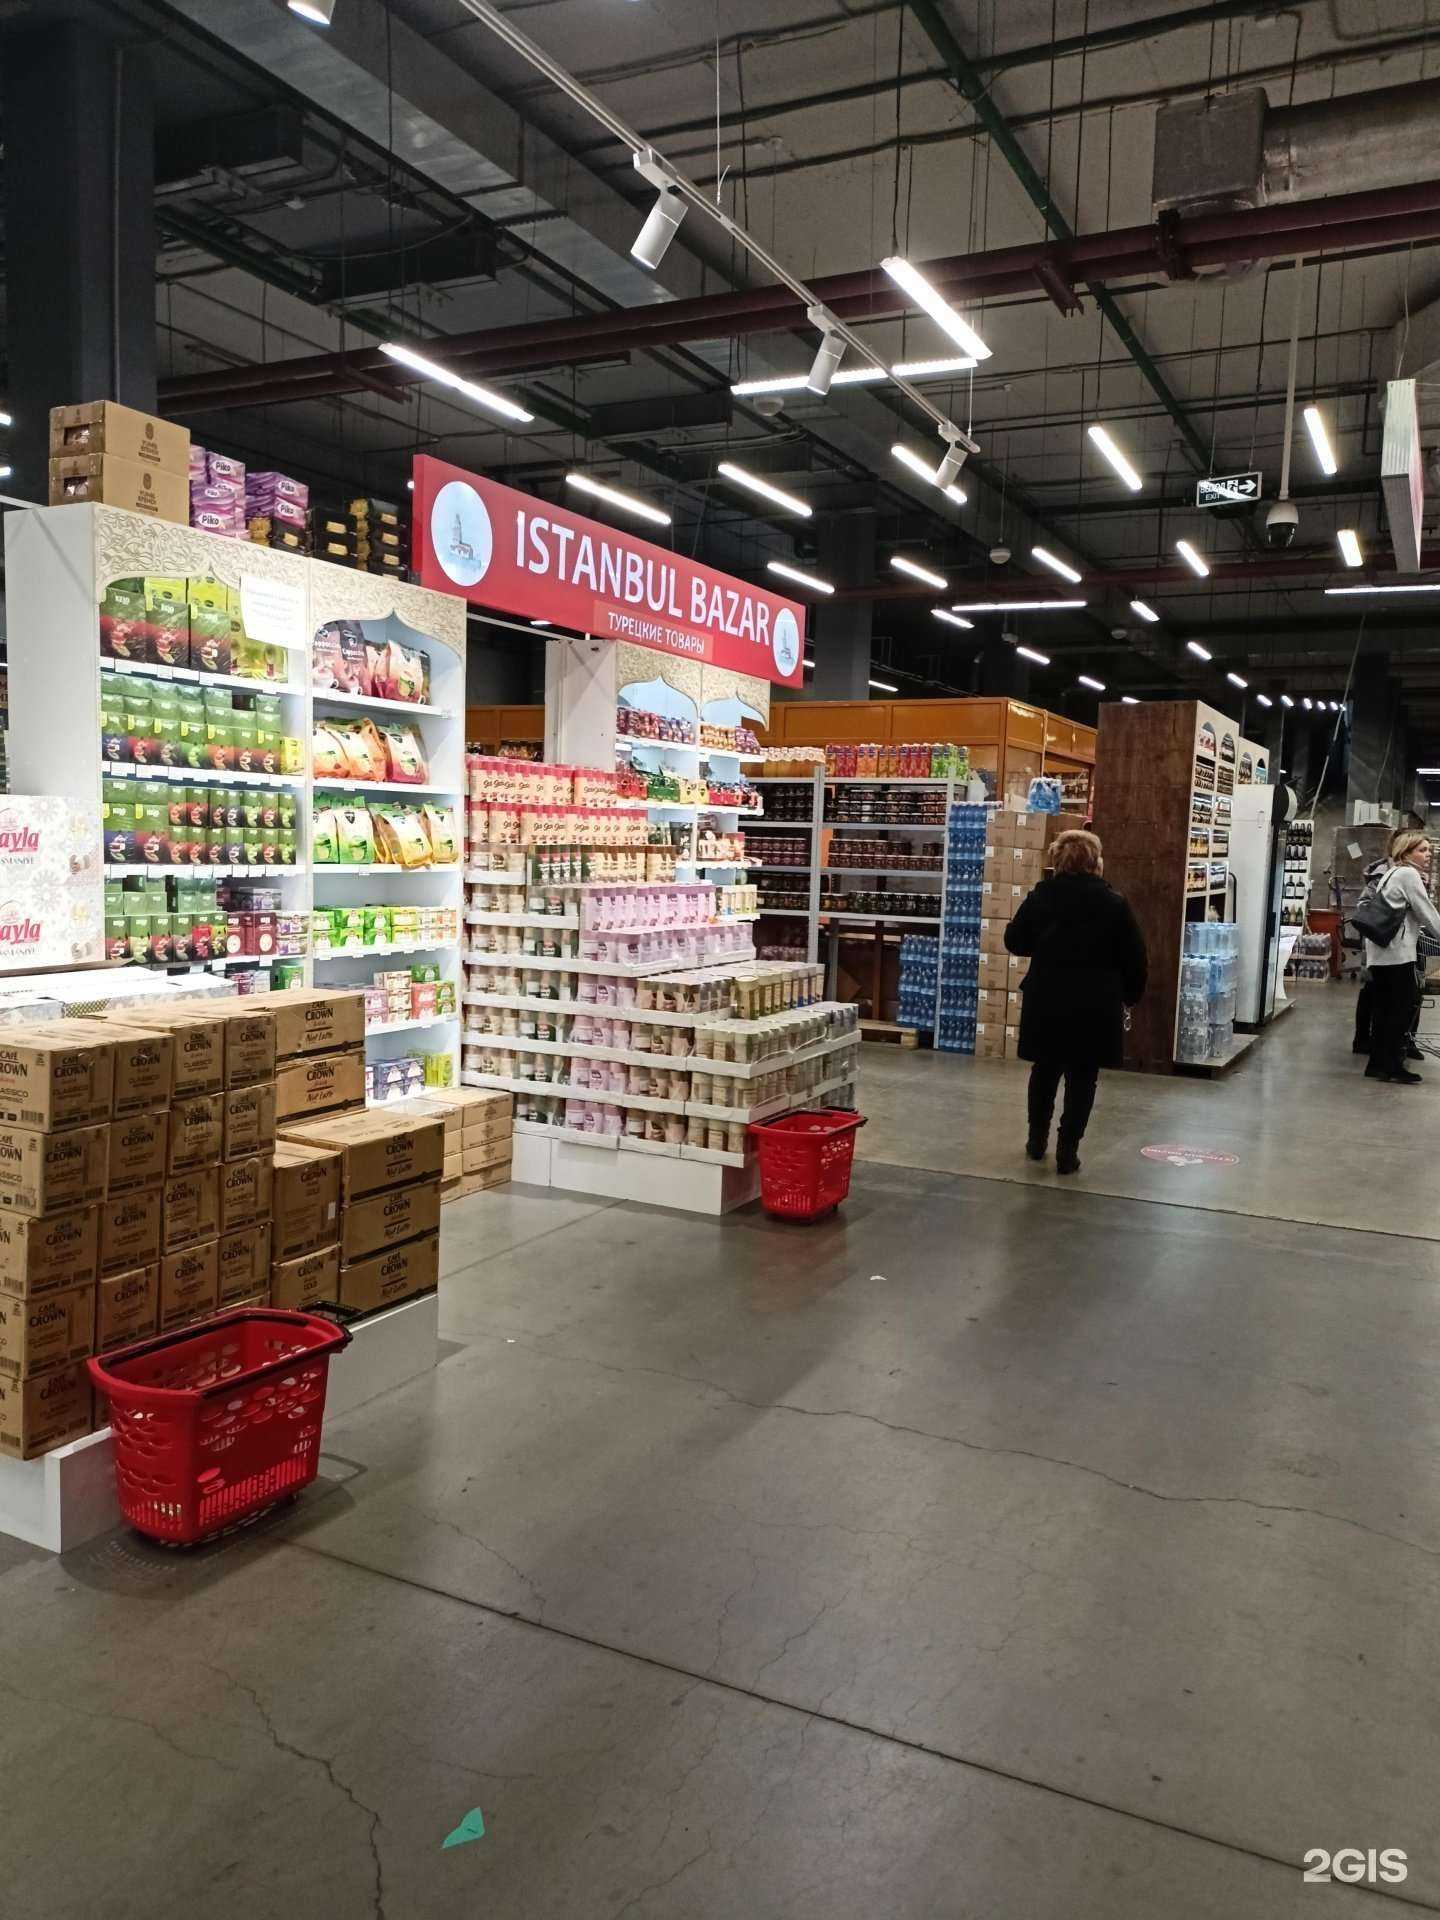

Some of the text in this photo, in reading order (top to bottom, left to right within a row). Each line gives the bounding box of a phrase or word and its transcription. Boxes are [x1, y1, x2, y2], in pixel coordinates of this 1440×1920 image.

[216, 462, 231, 472] Piko
[280, 482, 295, 492] Piko
[280, 503, 294, 514] Piko
[201, 515, 219, 525] Piko
[516, 510, 770, 646] ISTANBUL BAZAR
[608, 612, 704, 654] ТУРЕЦКИЕ ТОВАРЫ
[0, 826, 39, 852] ayla
[0, 918, 41, 944] ayla
[305, 1008, 333, 1021] CROWN
[240, 1030, 266, 1042] CROWN
[184, 1040, 212, 1052] CROWN
[130, 1054, 161, 1067] CROWN
[0, 1063, 28, 1077] ROWN
[54, 1064, 88, 1078] CROWN
[307, 1067, 334, 1081] CROWN
[229, 1103, 256, 1115] CROWN
[122, 1132, 154, 1146] CROWN
[0, 1147, 22, 1161] OWN
[46, 1147, 82, 1162] CROWN
[386, 1140, 415, 1155] CROWN
[226, 1175, 254, 1188] CROWN
[300, 1168, 327, 1183] CROWN
[384, 1199, 410, 1216] CROWN
[114, 1209, 147, 1226] CROWN
[46, 1229, 82, 1245] CROWN
[298, 1260, 324, 1277] CROWN
[381, 1258, 408, 1276] CROWN
[30, 1309, 66, 1327] CROWN
